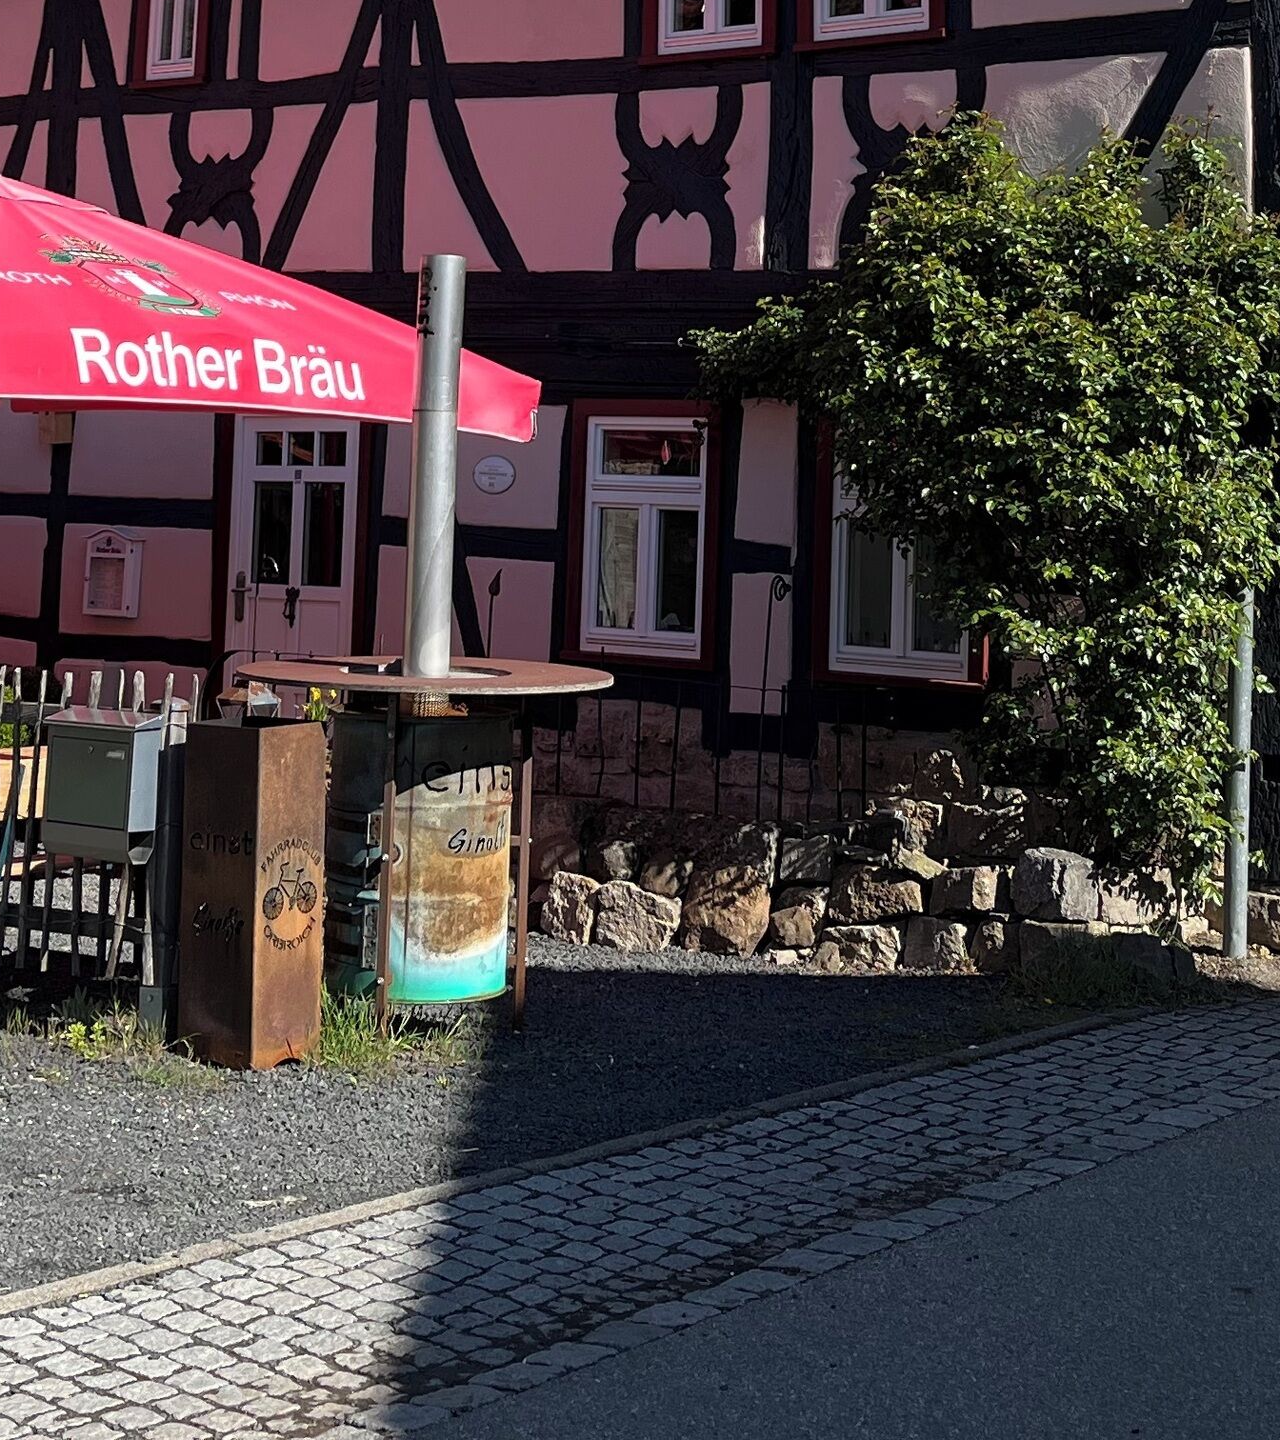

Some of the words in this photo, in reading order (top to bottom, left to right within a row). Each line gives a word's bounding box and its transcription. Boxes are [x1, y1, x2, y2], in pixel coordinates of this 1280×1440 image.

[70, 327, 242, 391] Rother
[253, 338, 366, 401] Bräu
[190, 824, 253, 856] einst
[261, 837, 322, 873] FAHRRADCLUB
